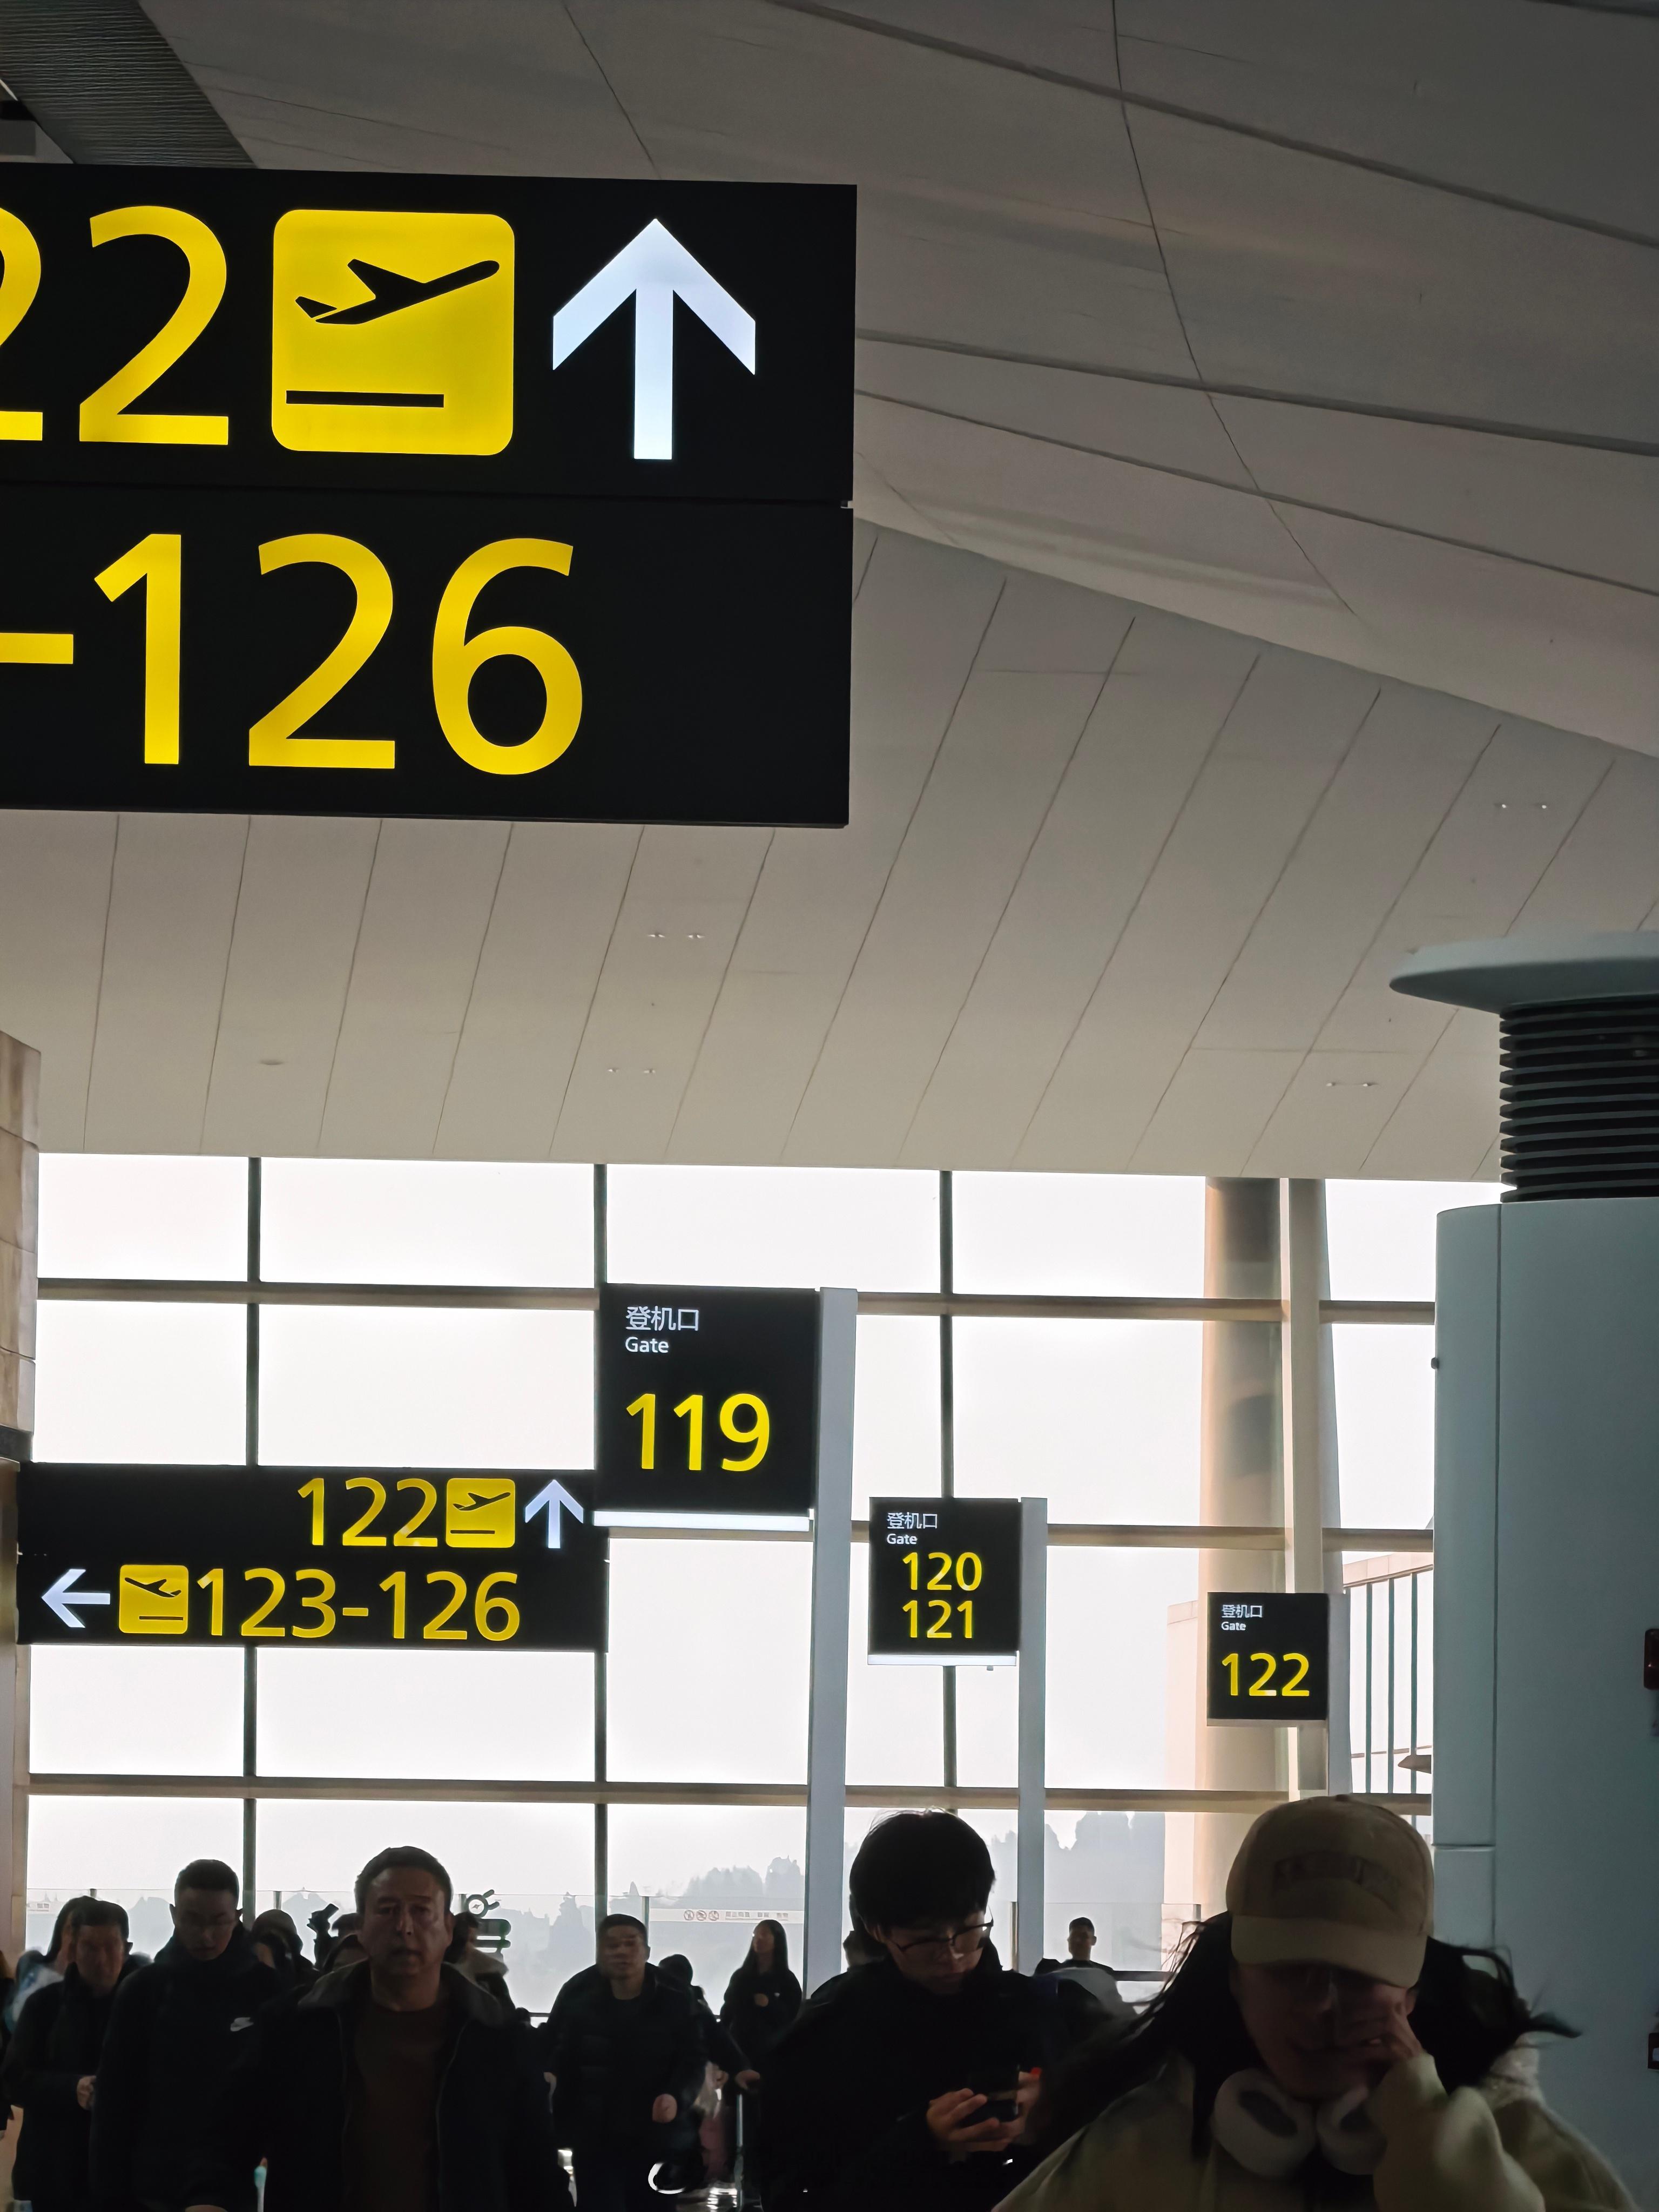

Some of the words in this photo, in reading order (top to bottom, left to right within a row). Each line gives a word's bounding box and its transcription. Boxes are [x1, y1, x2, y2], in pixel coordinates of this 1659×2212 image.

[625, 1305, 700, 1331] 登机口
[625, 1336, 669, 1353] Gate
[626, 1393, 770, 1472] 119
[298, 1477, 438, 1547] 122
[887, 1512, 938, 1529] 登机口
[886, 1533, 918, 1545] Gate
[902, 1552, 982, 1591] 120
[197, 1568, 520, 1641] 123-126
[902, 1600, 973, 1638] 121
[1221, 1604, 1263, 1618] 登机口
[1221, 1621, 1246, 1631] Gate
[1222, 1653, 1310, 1697] 122
